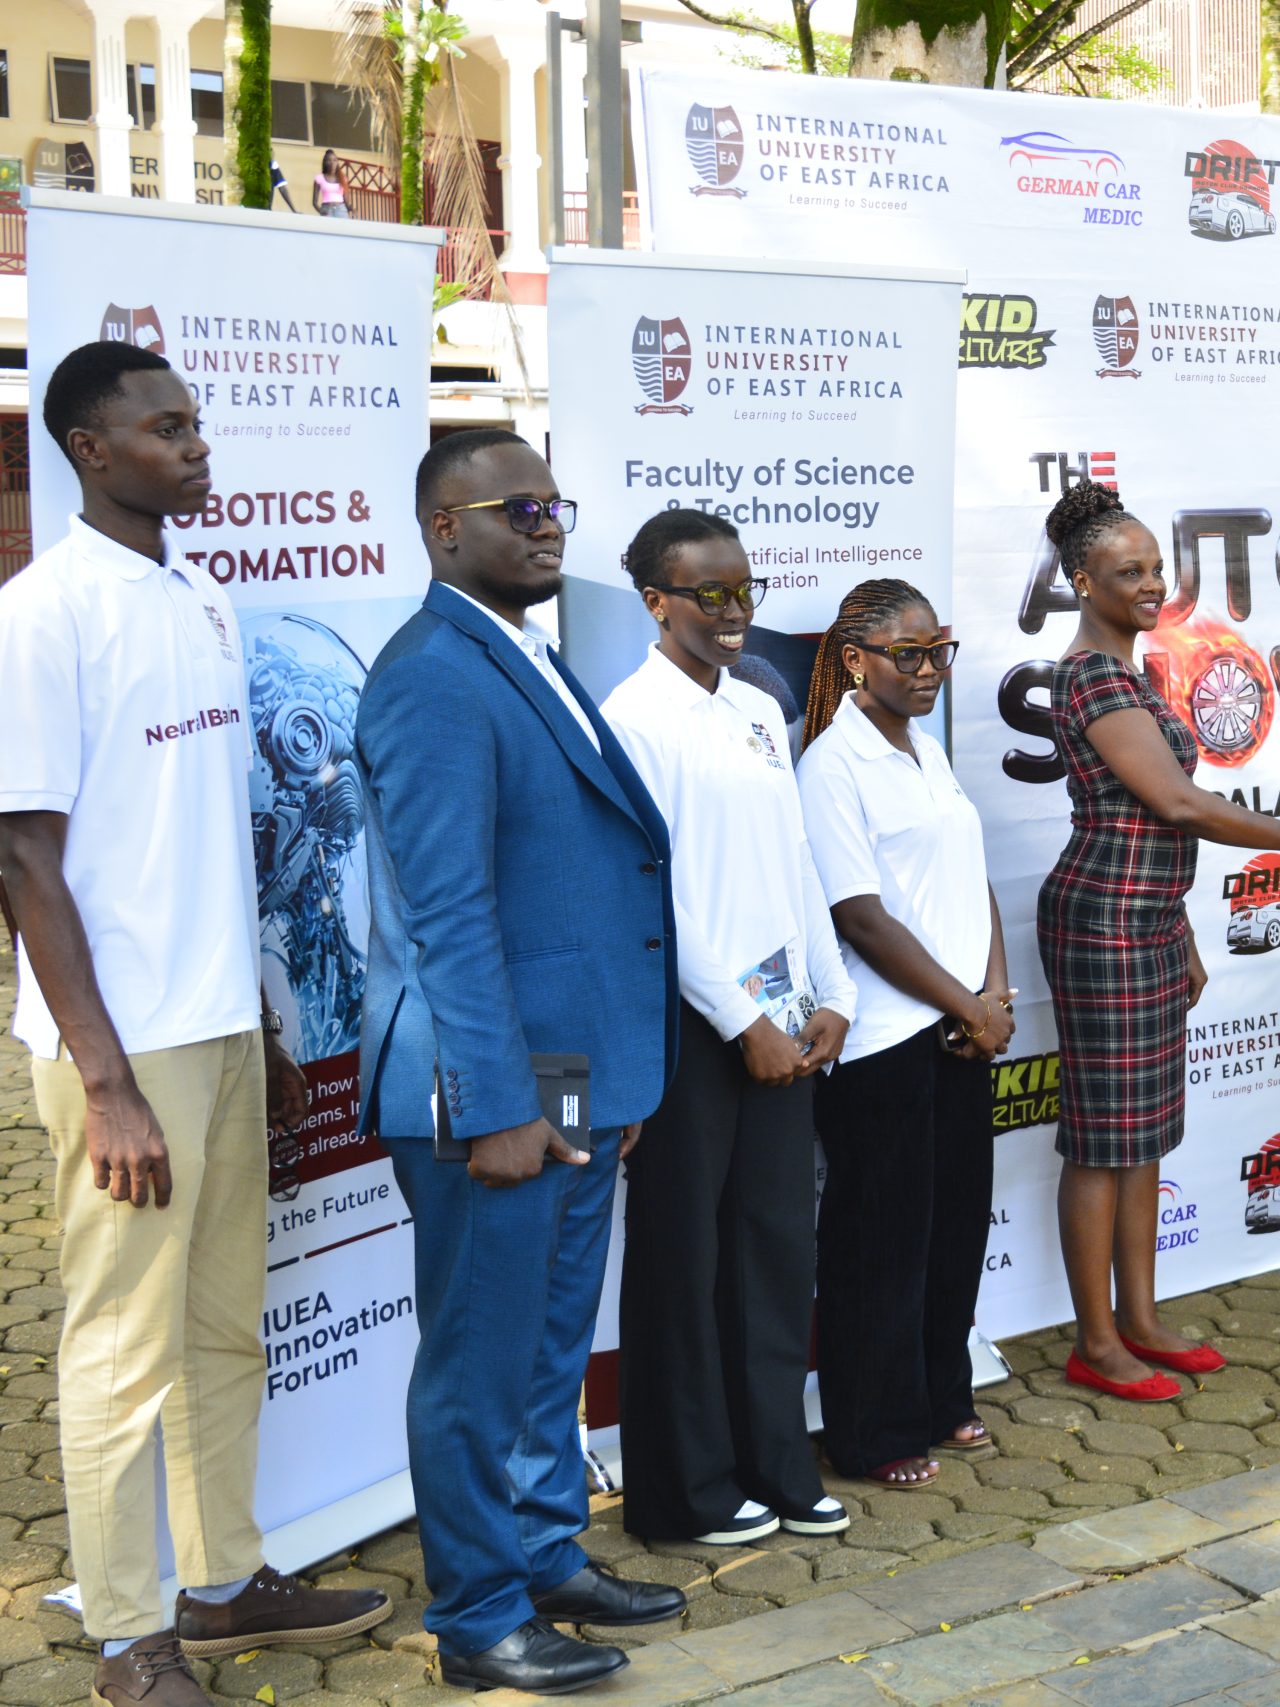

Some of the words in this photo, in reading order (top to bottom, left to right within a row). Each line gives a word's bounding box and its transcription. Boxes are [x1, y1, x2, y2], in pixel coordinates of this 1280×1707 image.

[692, 117, 708, 131] IU
[756, 114, 948, 146] INTERNATIONAL
[41, 151, 58, 166] IU
[719, 151, 738, 166] EA
[758, 139, 896, 165] UNIVERSITY
[760, 164, 789, 182] OF
[802, 165, 857, 187] EAST
[869, 172, 950, 193] AFRICA
[1017, 175, 1099, 197] GERMAN
[1104, 183, 1141, 200] CAR
[789, 193, 840, 209] Learning
[844, 197, 855, 208] to
[860, 198, 908, 211] Succeed
[1083, 207, 1143, 227] MEDIC
[960, 298, 1033, 333] KID
[1098, 307, 1110, 320] IU
[106, 322, 126, 341] IU
[181, 315, 399, 347] INTERNATIONAL
[638, 330, 655, 346] IU
[705, 325, 903, 349] INTERNATIONAL
[1119, 336, 1134, 349] EA
[1150, 324, 1257, 343] UNIVERSITY
[183, 349, 341, 376] UNIVERSITY
[707, 353, 848, 372] UNIVERSITY
[959, 337, 1043, 365] LTURE
[1152, 346, 1174, 362] OF
[1184, 347, 1225, 364] EAST
[664, 366, 685, 381] EA
[1175, 371, 1212, 385] Learning
[1217, 372, 1226, 383] to
[1230, 372, 1266, 384] Succeed
[231, 384, 295, 407] EAST
[309, 385, 401, 409] AFRICA
[707, 378, 735, 396] OF
[749, 379, 806, 397] EAST
[819, 380, 903, 399] AFRICA
[734, 409, 787, 422] Learning
[792, 410, 803, 420] to
[808, 409, 857, 421] Succeed
[214, 423, 272, 439] Learning
[276, 424, 291, 437] to
[297, 423, 352, 437] Succeed
[625, 458, 744, 493] Faculty
[754, 458, 786, 486] of
[794, 457, 915, 486] Science
[1029, 452, 1118, 491] THE
[162, 490, 336, 530] BOTICS
[347, 489, 371, 522] &
[694, 496, 880, 529] Technology
[185, 543, 385, 585] TOMATION
[746, 547, 809, 566] tificial
[815, 545, 923, 566] Intelligence
[1189, 1067, 1212, 1085] OF
[1222, 1057, 1265, 1079] EAST
[318, 1077, 353, 1099] how
[1212, 1084, 1252, 1099] Learning
[1255, 1081, 1264, 1090] to
[309, 1130, 366, 1156] alrea
[281, 1203, 316, 1232] the
[322, 1183, 389, 1219] Future
[1161, 1204, 1197, 1225] CAR
[1155, 1228, 1199, 1252] EDIC
[263, 1291, 333, 1338] IUEA
[266, 1296, 413, 1369] Innovation
[267, 1349, 358, 1401] Forum
